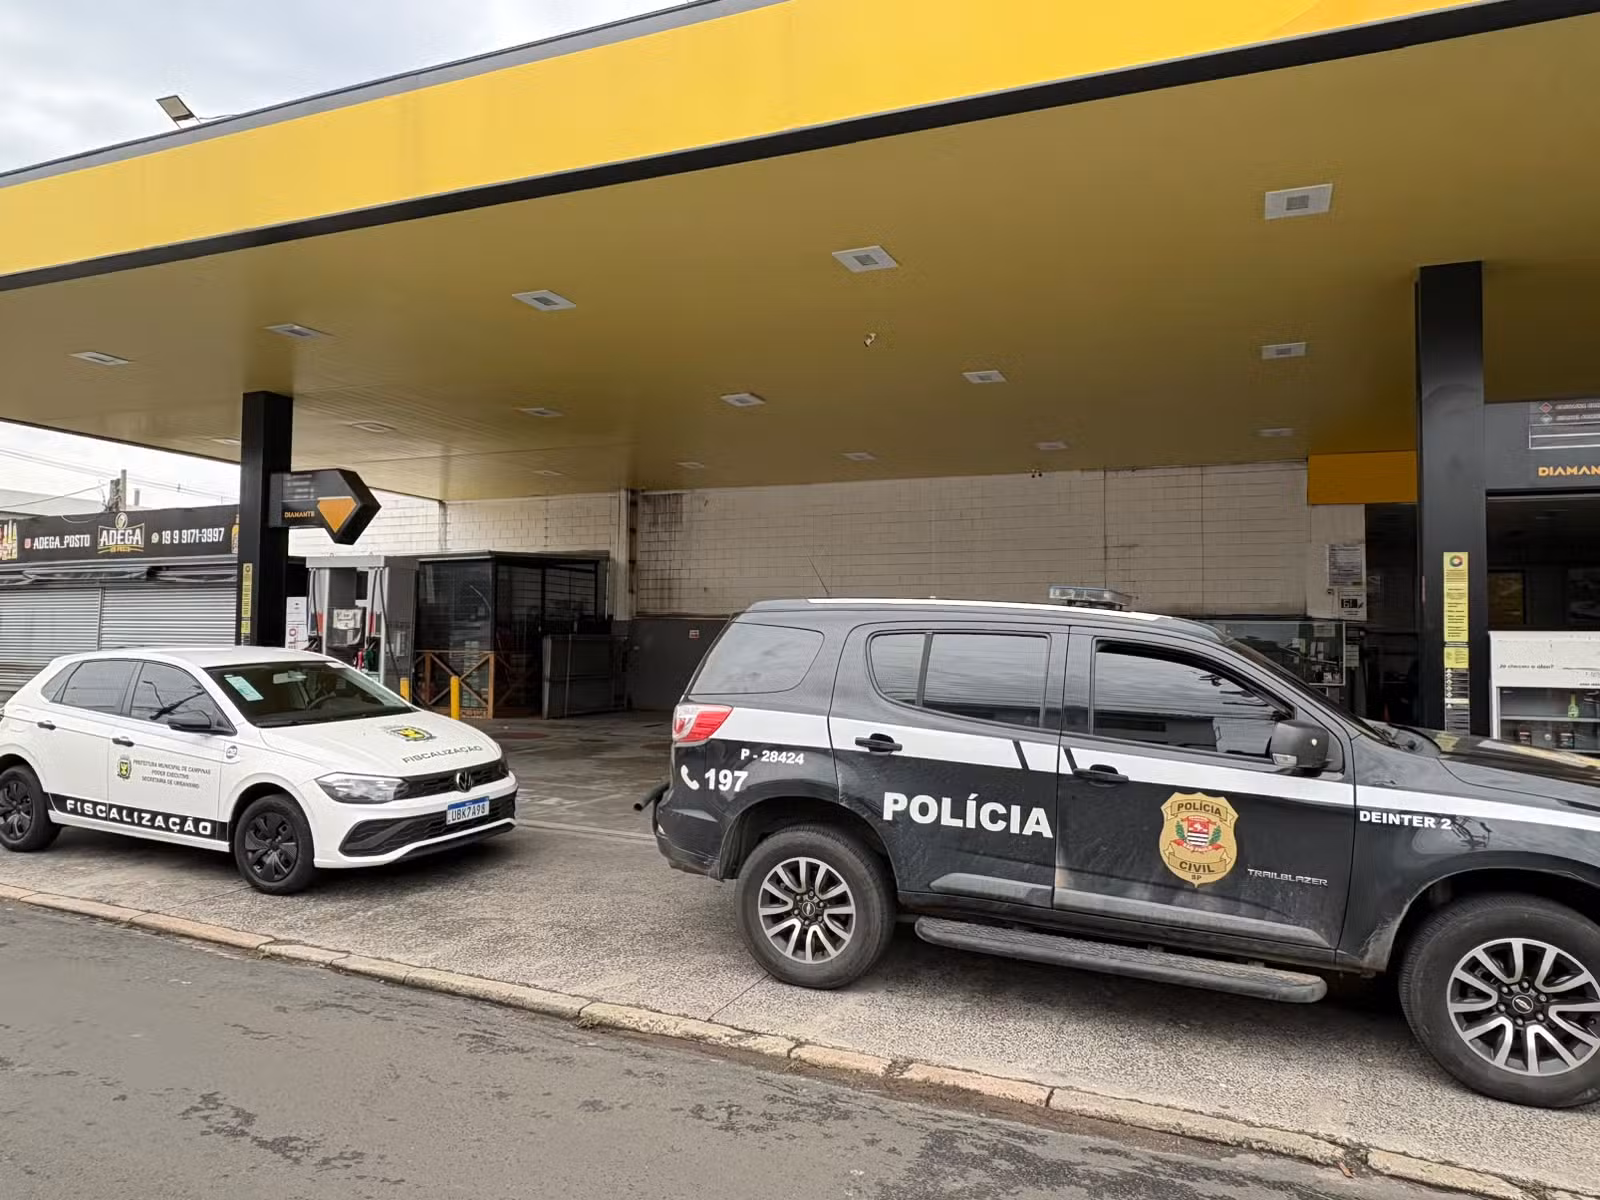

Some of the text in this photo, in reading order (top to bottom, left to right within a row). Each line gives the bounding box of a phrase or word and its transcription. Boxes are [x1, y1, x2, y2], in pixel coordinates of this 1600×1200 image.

[33, 534, 90, 549] ADEGA_POSTO
[100, 528, 142, 546] ADEGA
[162, 527, 225, 544] 19 9 9171-3997
[740, 748, 750, 760] P
[760, 750, 804, 765] 28424
[133, 759, 157, 768] PREFEITURA
[158, 763, 180, 771] MUNICIPAL
[188, 767, 211, 775] CAMPINAS
[704, 768, 749, 792] 197
[66, 800, 211, 834] FISCALIZAÇÃO
[883, 792, 1054, 838] POLÍCIA
[1360, 810, 1452, 830] DEINTER 2
[1179, 861, 1215, 873] CIVIL
[1247, 868, 1329, 886] TRAILBLAZER
